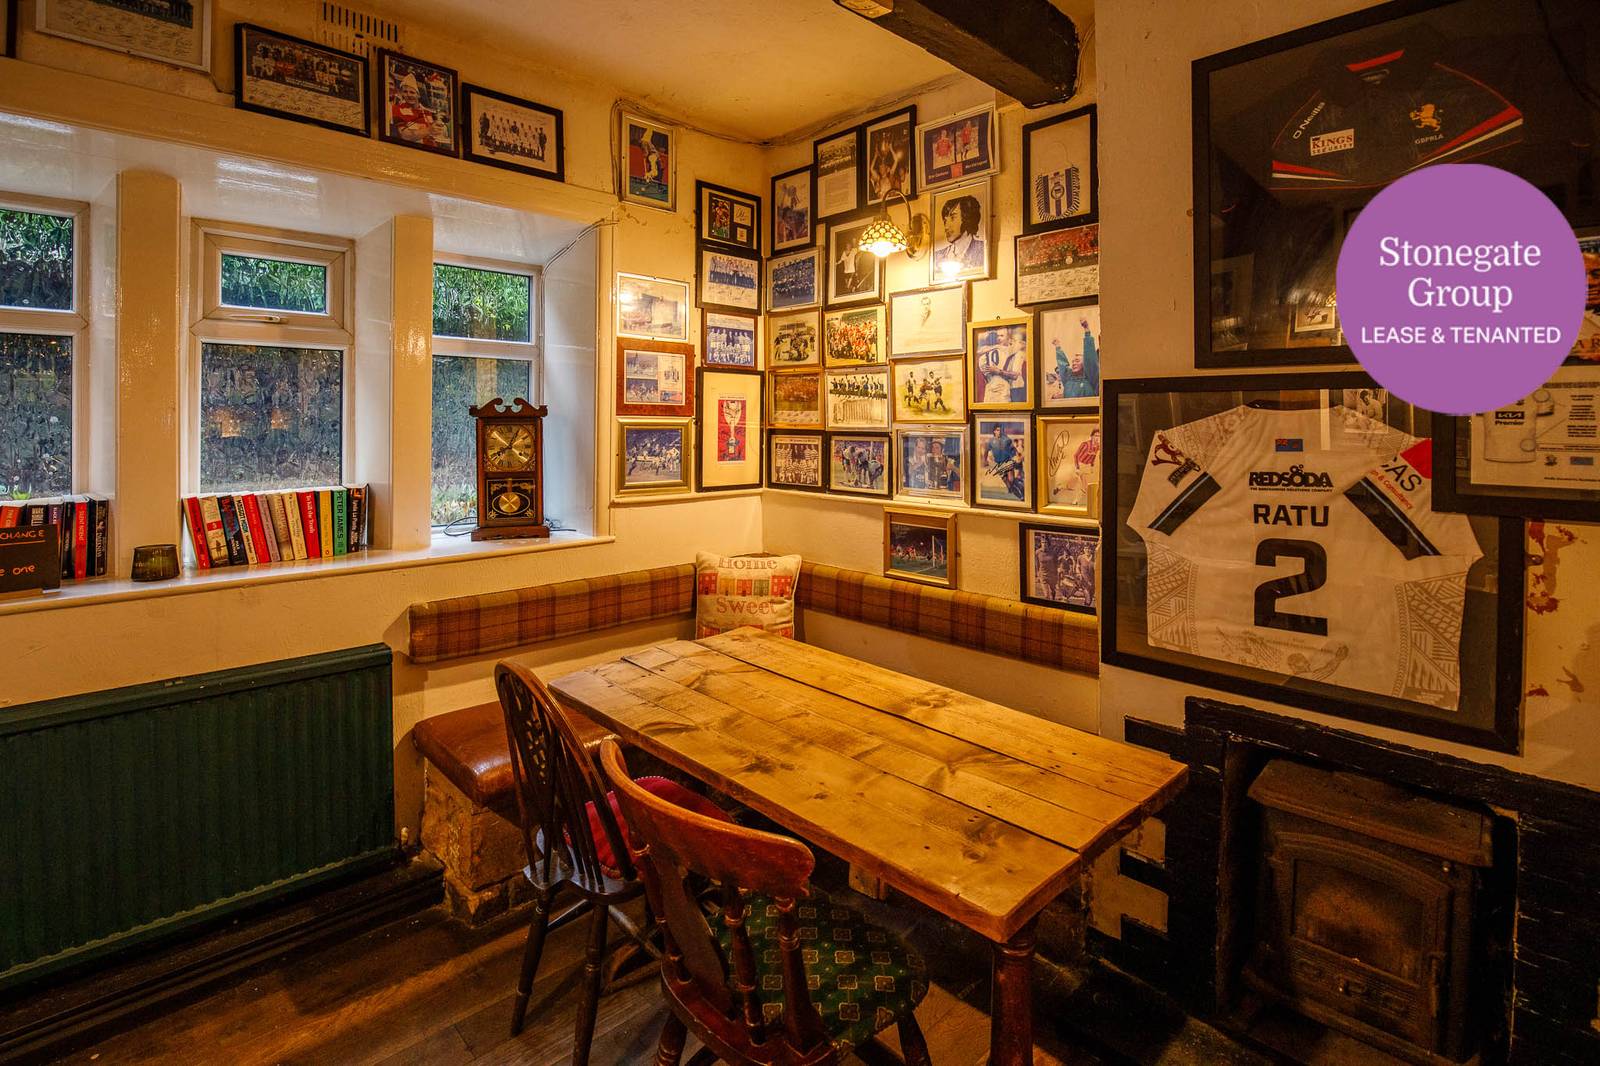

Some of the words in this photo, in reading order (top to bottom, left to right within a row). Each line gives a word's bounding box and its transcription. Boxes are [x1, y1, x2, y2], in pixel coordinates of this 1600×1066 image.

[1311, 134, 1353, 150] KINGS
[984, 348, 1000, 367] 10
[1249, 470, 1334, 488] REDSODA
[1253, 504, 1329, 527] RATU
[12, 564, 36, 575] one
[718, 557, 778, 570] Home
[1254, 538, 1328, 636] 2
[716, 596, 778, 615] Sweet
